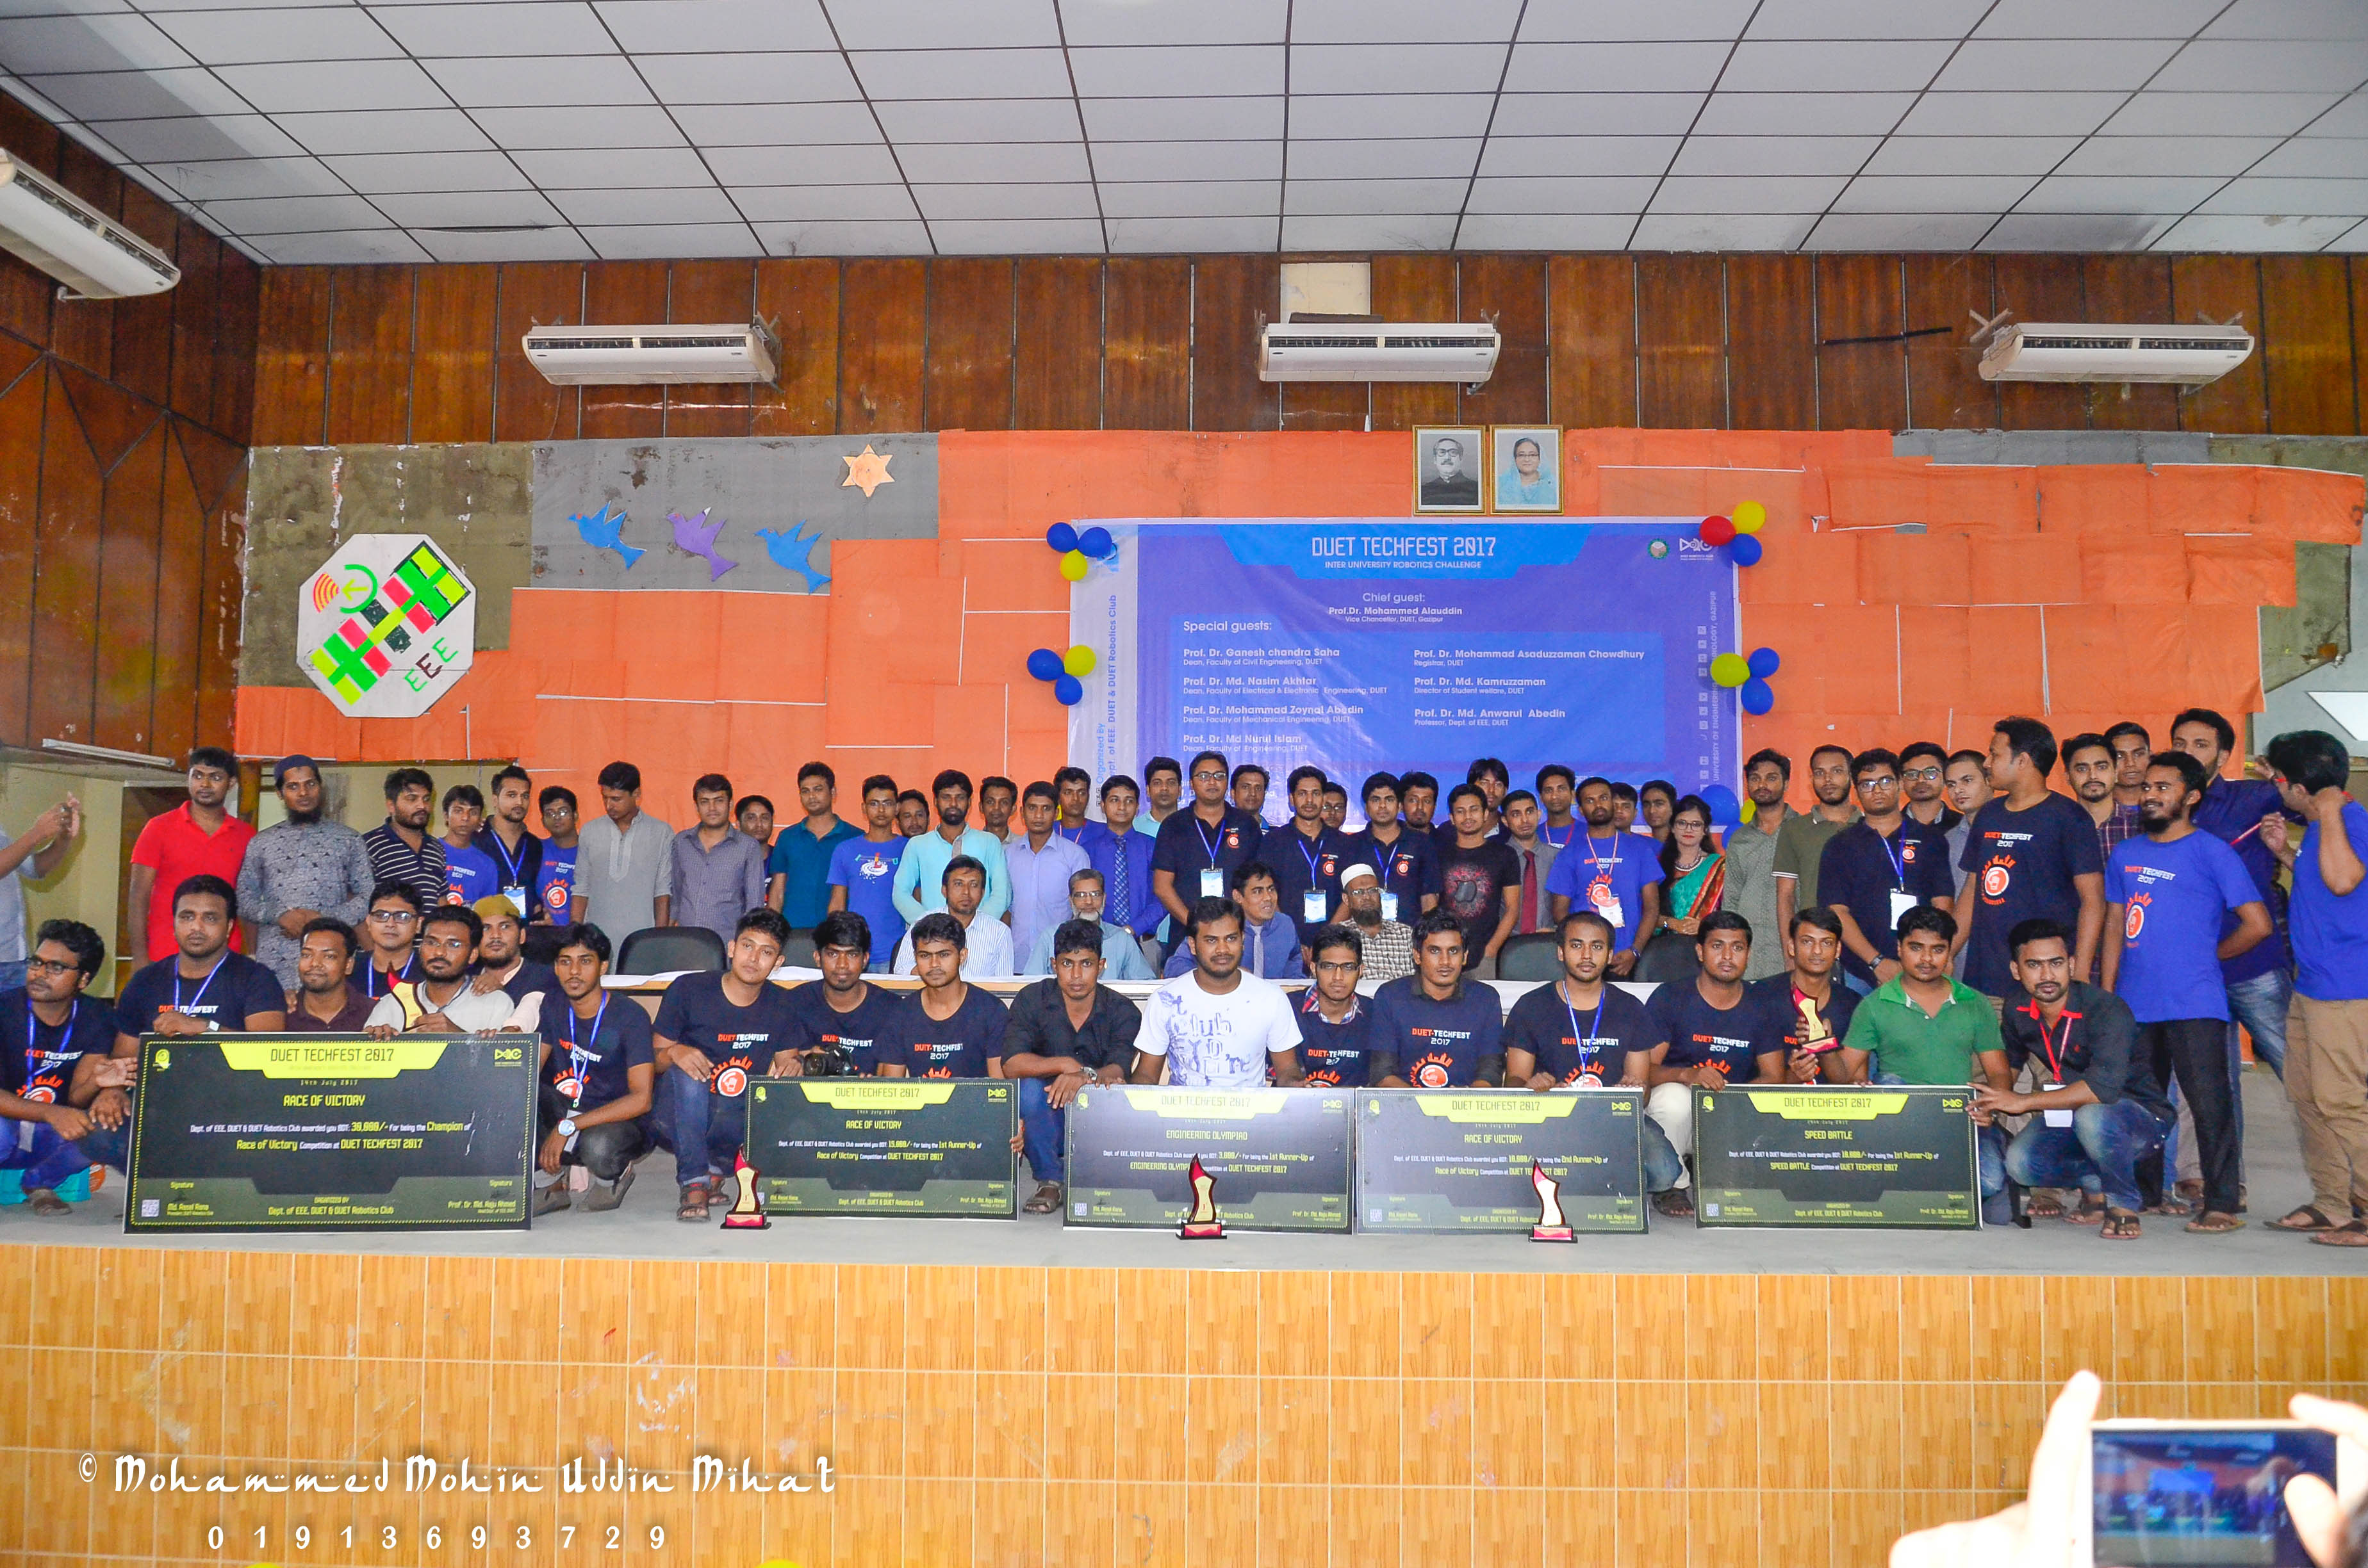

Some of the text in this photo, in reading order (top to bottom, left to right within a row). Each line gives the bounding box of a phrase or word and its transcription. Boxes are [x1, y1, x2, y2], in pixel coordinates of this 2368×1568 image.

[1311, 536, 1496, 557] DUET TECHFEST 2017
[1362, 592, 1426, 605] Chief guest:
[1108, 595, 1116, 617] Club
[1364, 606, 1419, 616] Mohammed
[1421, 606, 1463, 616] Alauddin
[1183, 620, 1272, 633] Special guests:
[1108, 620, 1116, 662] Robotics
[1183, 648, 1340, 657] Prof. Dr. Ganesh chandra Saha
[1414, 649, 1645, 660] Prof. Dr. Mohammad Asaduzzaman Chowdhury
[1108, 664, 1116, 687] DUET
[1183, 677, 1317, 686] Prof. Dr. Md. Nasim Akhtar
[1414, 677, 1546, 686] Prof. Dr. Md. Kamruzzaman
[1108, 700, 1116, 723] DUET
[1183, 705, 1364, 715] Prof. Dr. Mohammad Zoynal Abedin
[1414, 709, 1565, 718] Prof. Dr. Md. Anwarul Abedin
[1183, 735, 1302, 744] Prof. Dr. Md Nurul Islam
[1096, 723, 1106, 785] Organized By
[270, 1049, 395, 1061] DUET TECHFEST 2017
[835, 1088, 919, 1098] DUET TECHFEST 2017
[283, 1094, 366, 1107] RACE OF VICTORY
[1161, 1096, 1251, 1107] DUET TECHFEST 2017
[1452, 1100, 1540, 1111] DUET TECHFEST 2017
[1784, 1097, 1871, 1107] DUET TECHFEST 2017
[427, 1121, 463, 1132] Champion
[845, 1120, 902, 1129] RACE OF VICTORY
[1165, 1130, 1248, 1140] ENGINEERING OLYMPIAD
[1464, 1134, 1523, 1143] RACE OF VICTORY
[1804, 1130, 1853, 1140] SPEED BATTLE
[236, 1138, 423, 1152] Race of Victory DUET TECHFEST 2017
